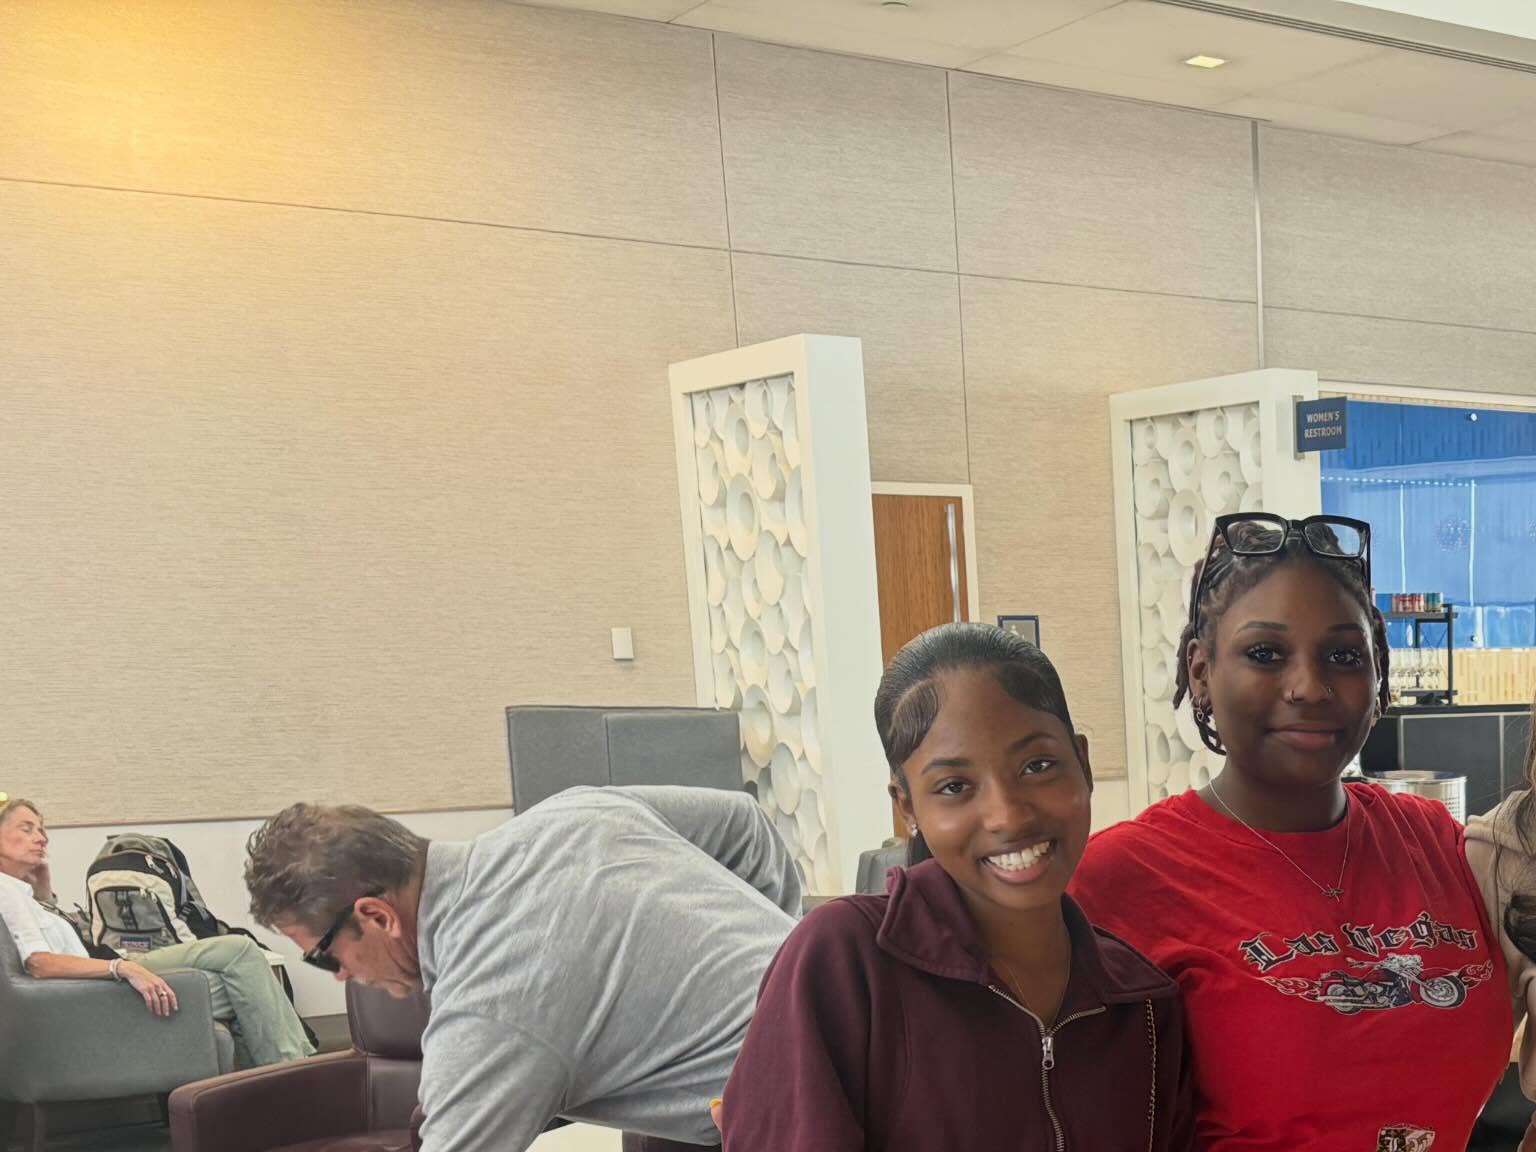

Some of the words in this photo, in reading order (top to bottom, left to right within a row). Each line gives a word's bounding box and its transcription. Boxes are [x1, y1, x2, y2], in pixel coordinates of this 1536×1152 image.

[1304, 426, 1343, 438] RESTROOM
[1239, 932, 1339, 972] Las
[1342, 911, 1478, 956] Vegas
